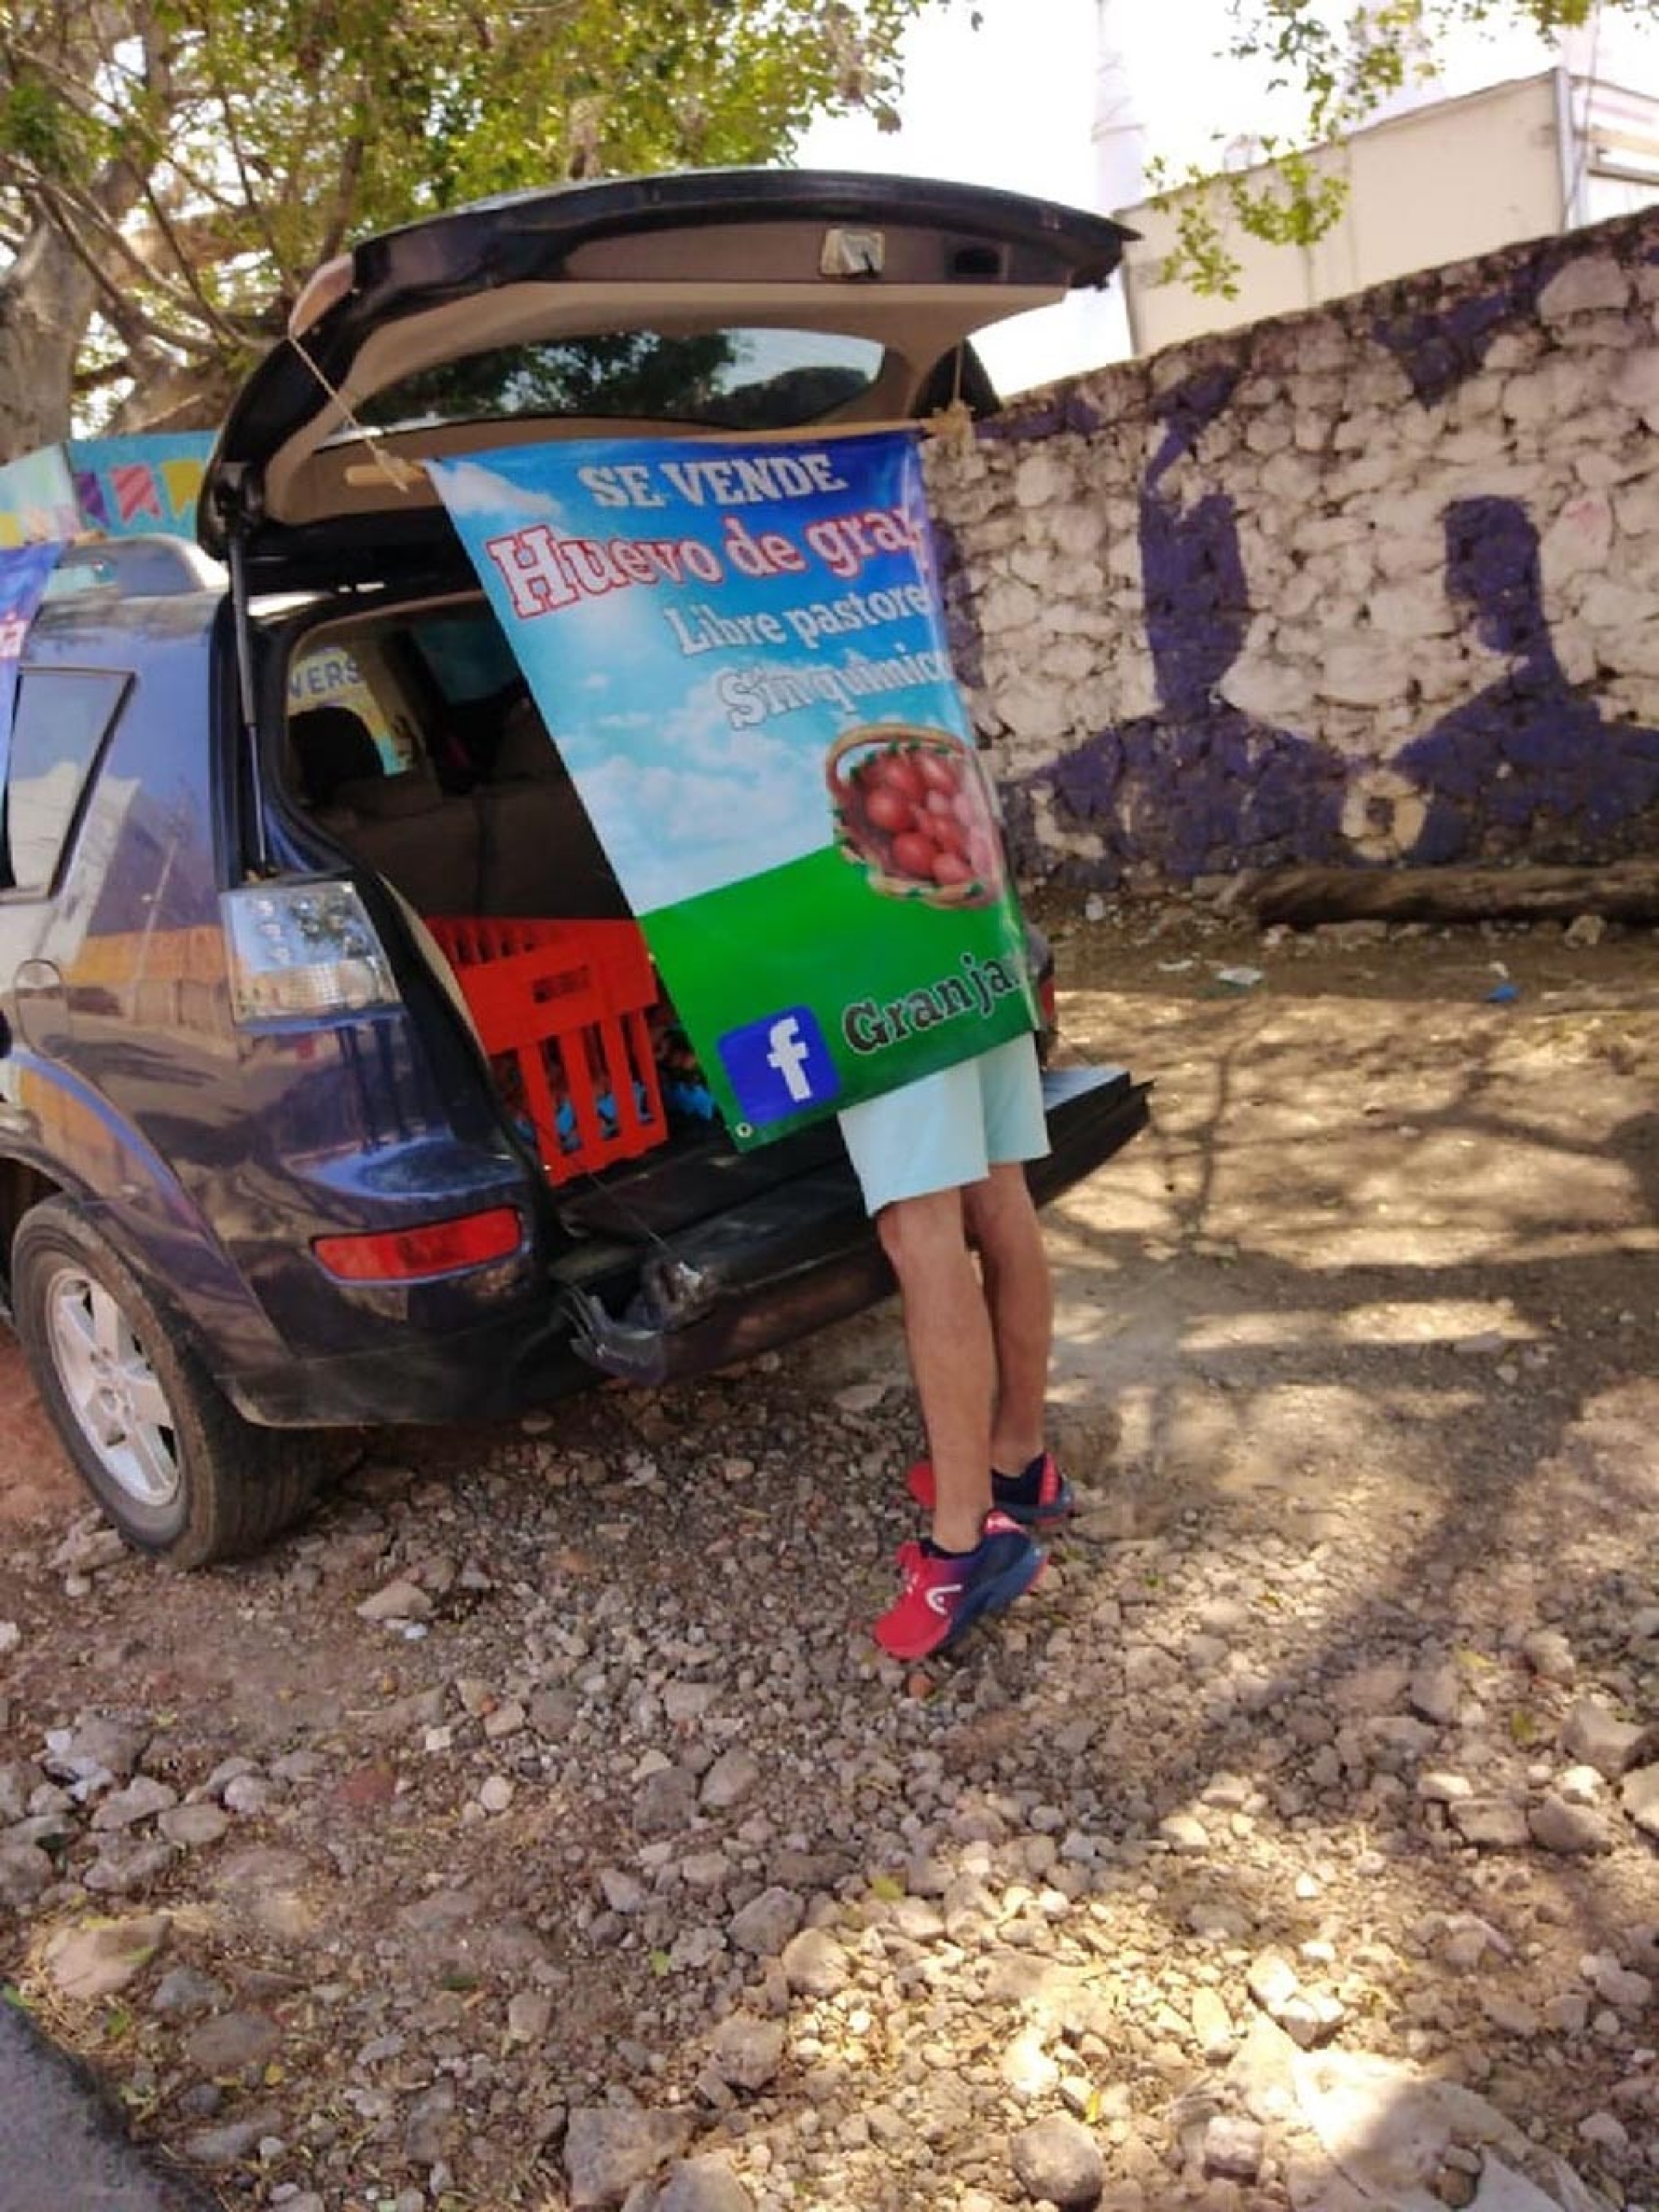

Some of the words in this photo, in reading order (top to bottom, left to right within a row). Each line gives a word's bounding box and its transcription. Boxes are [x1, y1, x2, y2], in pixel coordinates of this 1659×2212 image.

[577, 461, 665, 509] SE
[663, 453, 849, 508] VENDE
[484, 524, 724, 620] Huevo
[724, 513, 808, 579] de
[664, 604, 787, 657] Libre
[842, 951, 1016, 1053] Granja
[766, 1015, 812, 1103] f
